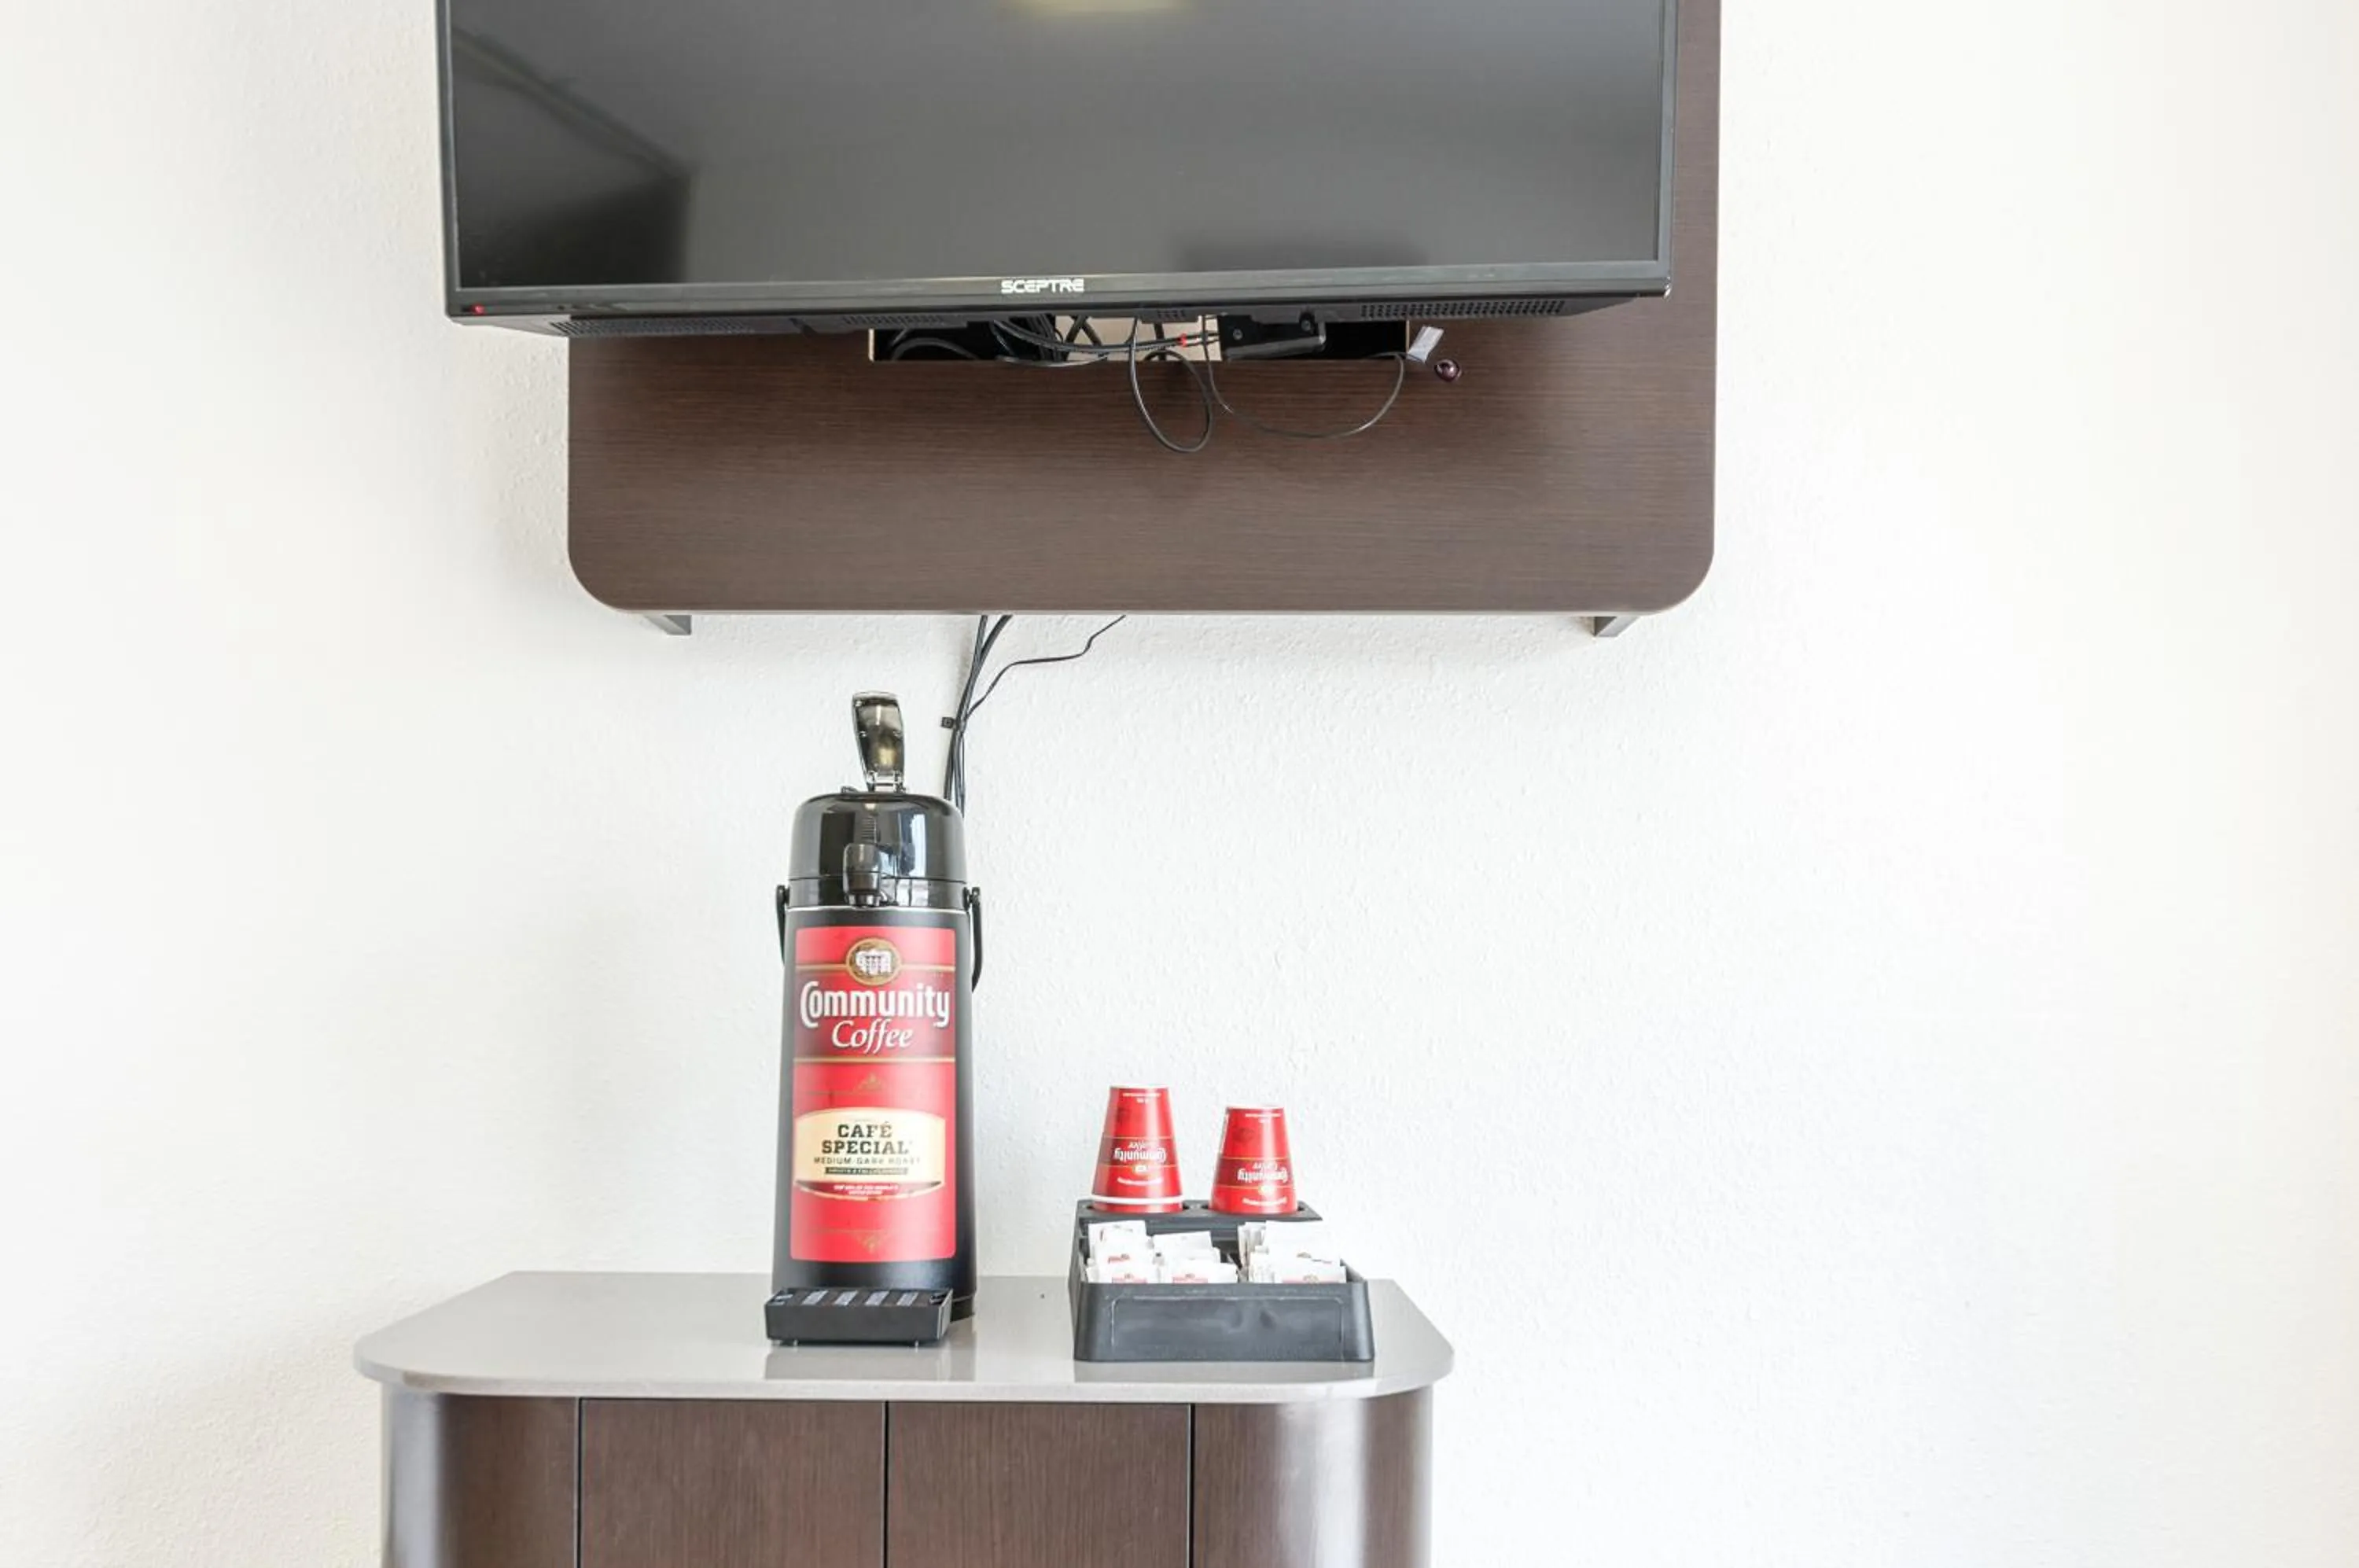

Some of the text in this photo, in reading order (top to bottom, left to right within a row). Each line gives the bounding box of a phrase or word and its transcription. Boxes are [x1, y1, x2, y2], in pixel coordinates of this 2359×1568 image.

[1001, 278, 1085, 294] SCEPTRE
[800, 981, 951, 1028] Community
[831, 1018, 914, 1055] Coffee
[837, 1121, 893, 1138] CAFÉ
[821, 1140, 910, 1155] SPECIAL
